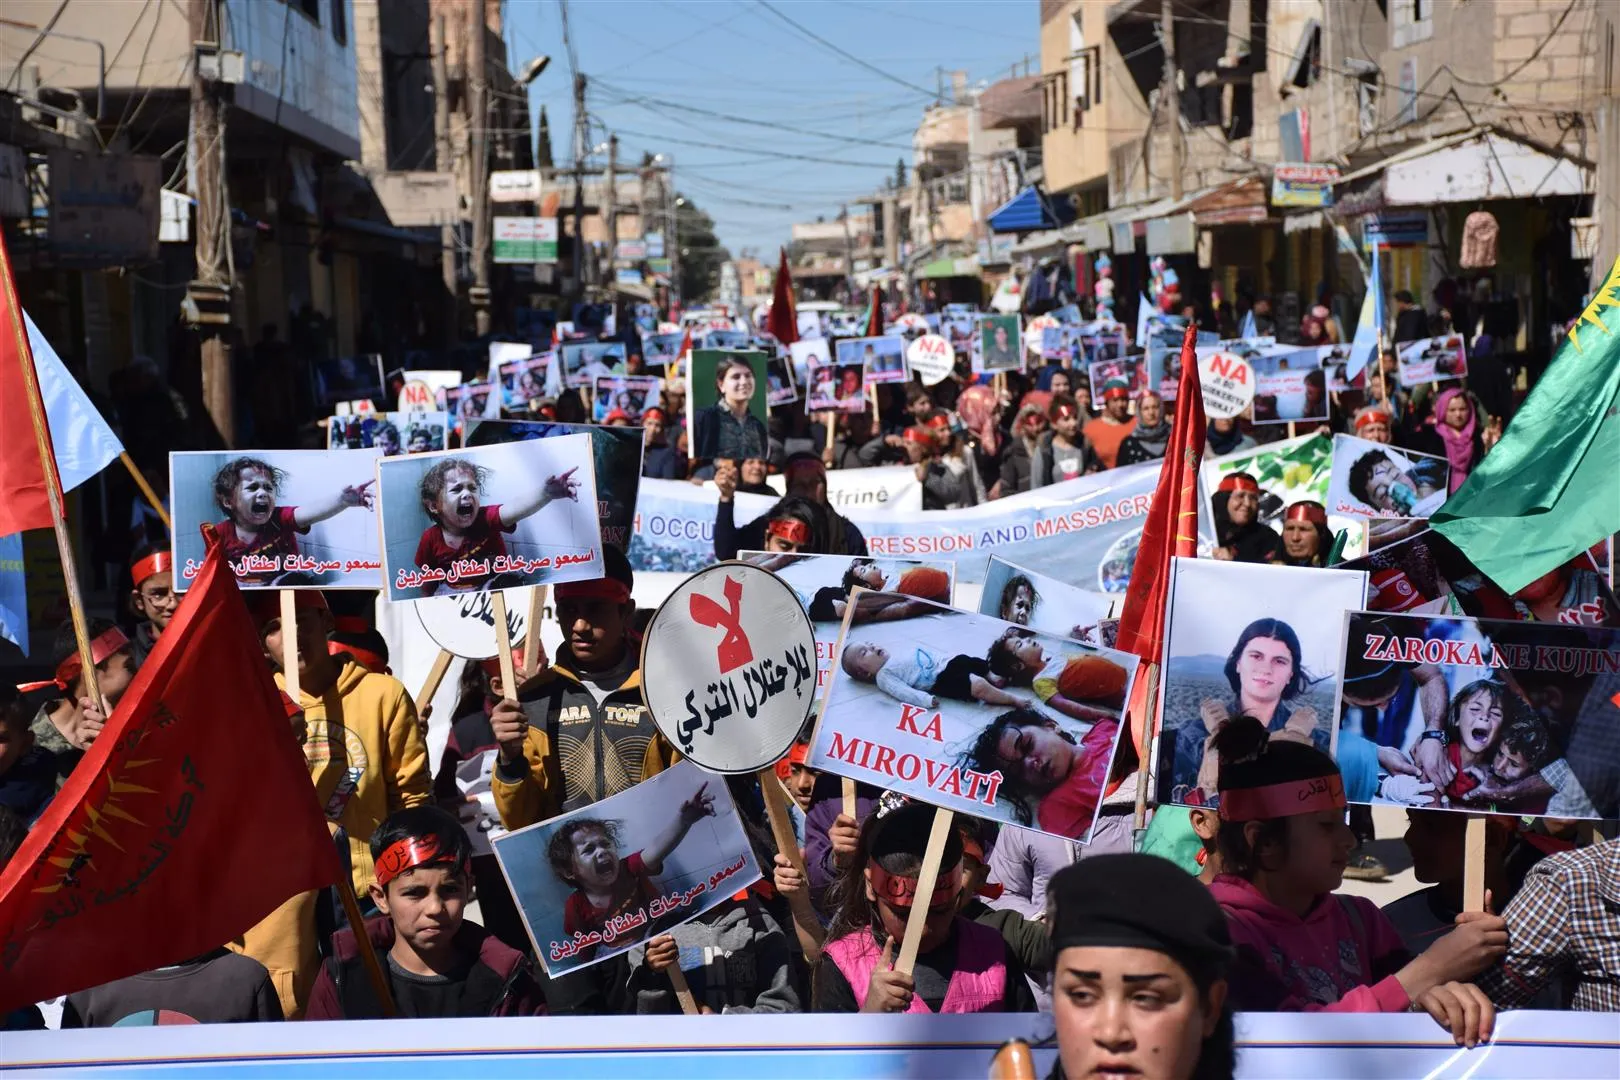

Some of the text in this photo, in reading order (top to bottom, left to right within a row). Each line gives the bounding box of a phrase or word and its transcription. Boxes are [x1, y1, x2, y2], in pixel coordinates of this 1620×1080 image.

[919, 337, 947, 356] NA
[1209, 353, 1247, 385] NA
[405, 386, 429, 404] NA
[650, 516, 714, 542] OCCU
[866, 534, 974, 554] RESSION
[980, 526, 1028, 548] AND
[1035, 492, 1153, 538] MASSACR
[236, 554, 281, 577] اطفال
[283, 554, 341, 575] صرخات
[344, 557, 382, 572] سمعو
[395, 548, 596, 589] اسمعو صرخات اطفال عفرين
[689, 574, 754, 675] لا
[1363, 633, 1484, 667] ZAROKA
[1490, 642, 1531, 670] NE
[676, 676, 740, 755] التركي
[895, 703, 944, 743] KA
[825, 731, 1004, 807] MIROVATÎ
[550, 854, 747, 961] اسمعو صرخات اطفال عفرين
